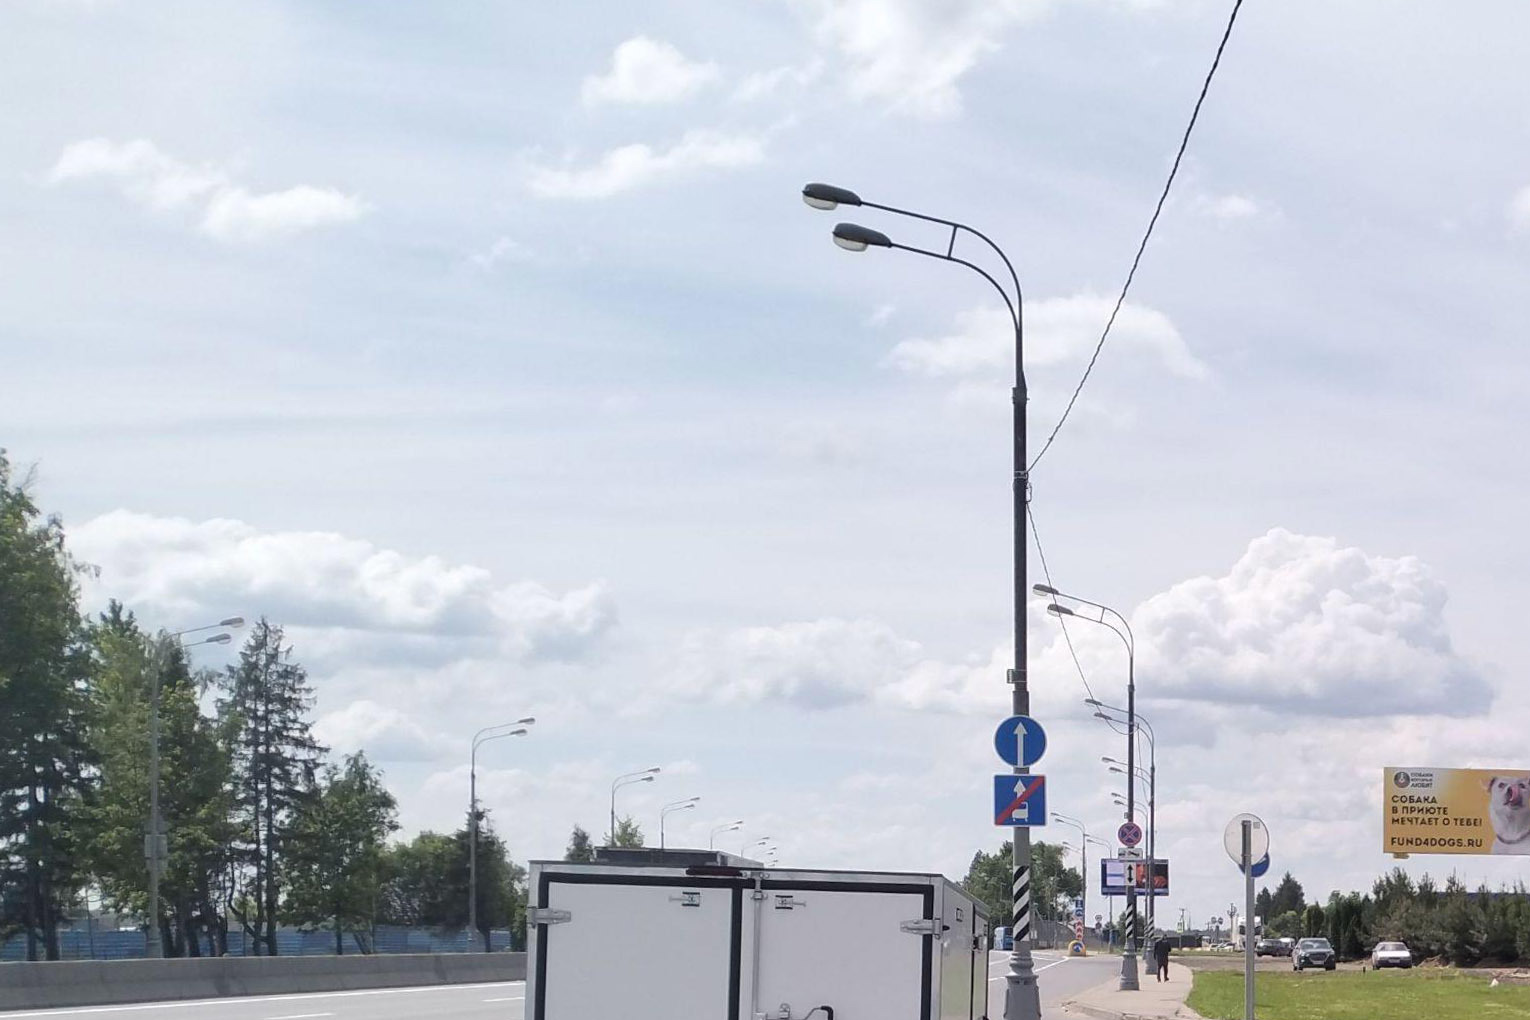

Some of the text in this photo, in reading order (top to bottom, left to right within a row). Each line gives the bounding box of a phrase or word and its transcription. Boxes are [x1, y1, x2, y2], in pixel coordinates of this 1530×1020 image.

[1391, 794, 1438, 804] СОБАКА
[1391, 806, 1449, 816] В ПРИЮТЕ
[1391, 816, 1483, 827] МЕЧТАЕТ О ТЕБЕ!
[1391, 836, 1483, 848] FUND4DOGS.RU
